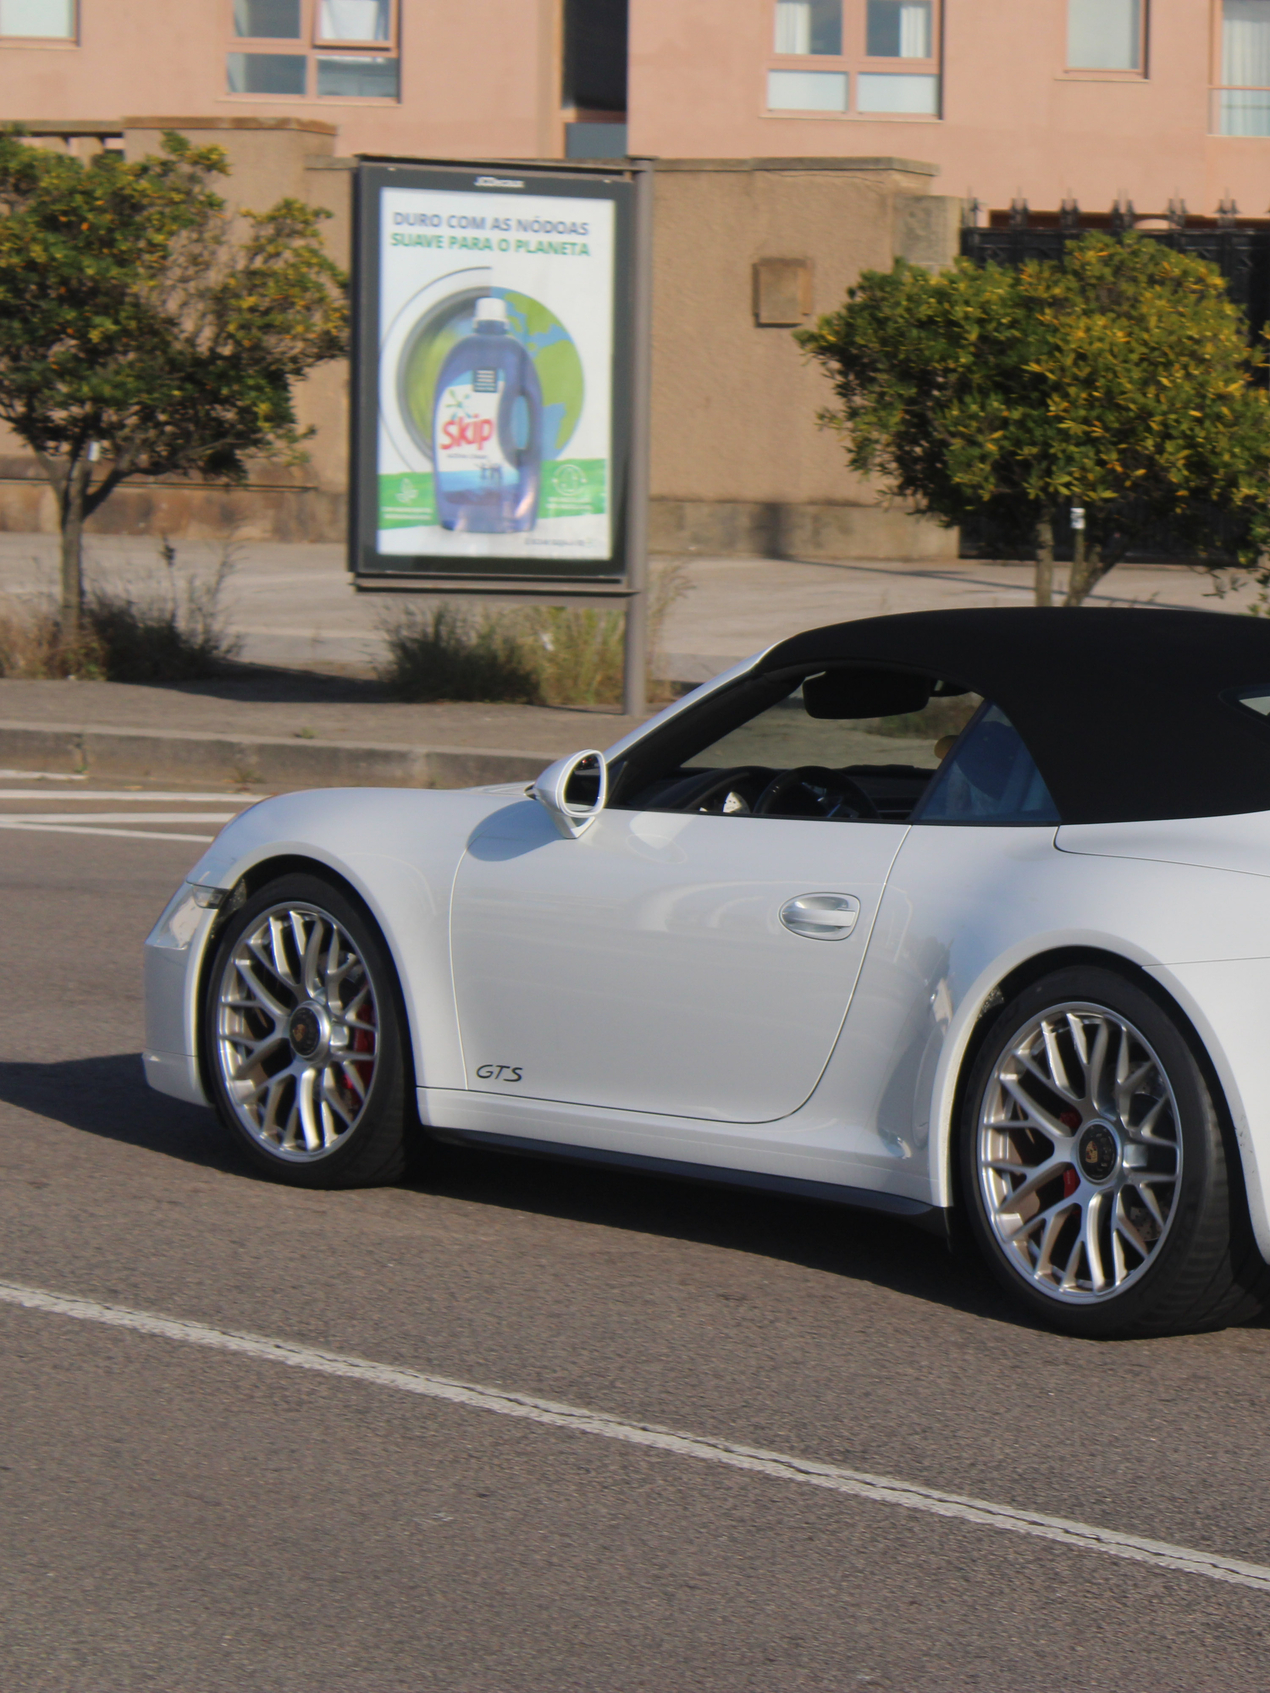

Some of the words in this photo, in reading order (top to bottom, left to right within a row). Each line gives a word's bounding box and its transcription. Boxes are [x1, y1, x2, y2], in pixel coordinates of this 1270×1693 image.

[393, 212, 442, 228] DURO
[447, 215, 486, 230] COM
[490, 217, 512, 232] AS
[516, 216, 590, 236] NÓDOAS
[391, 232, 445, 249] SUAVE
[449, 235, 493, 251] PARA
[498, 238, 510, 252] O
[515, 238, 591, 257] PLANETA
[476, 1064, 523, 1082] GTS
